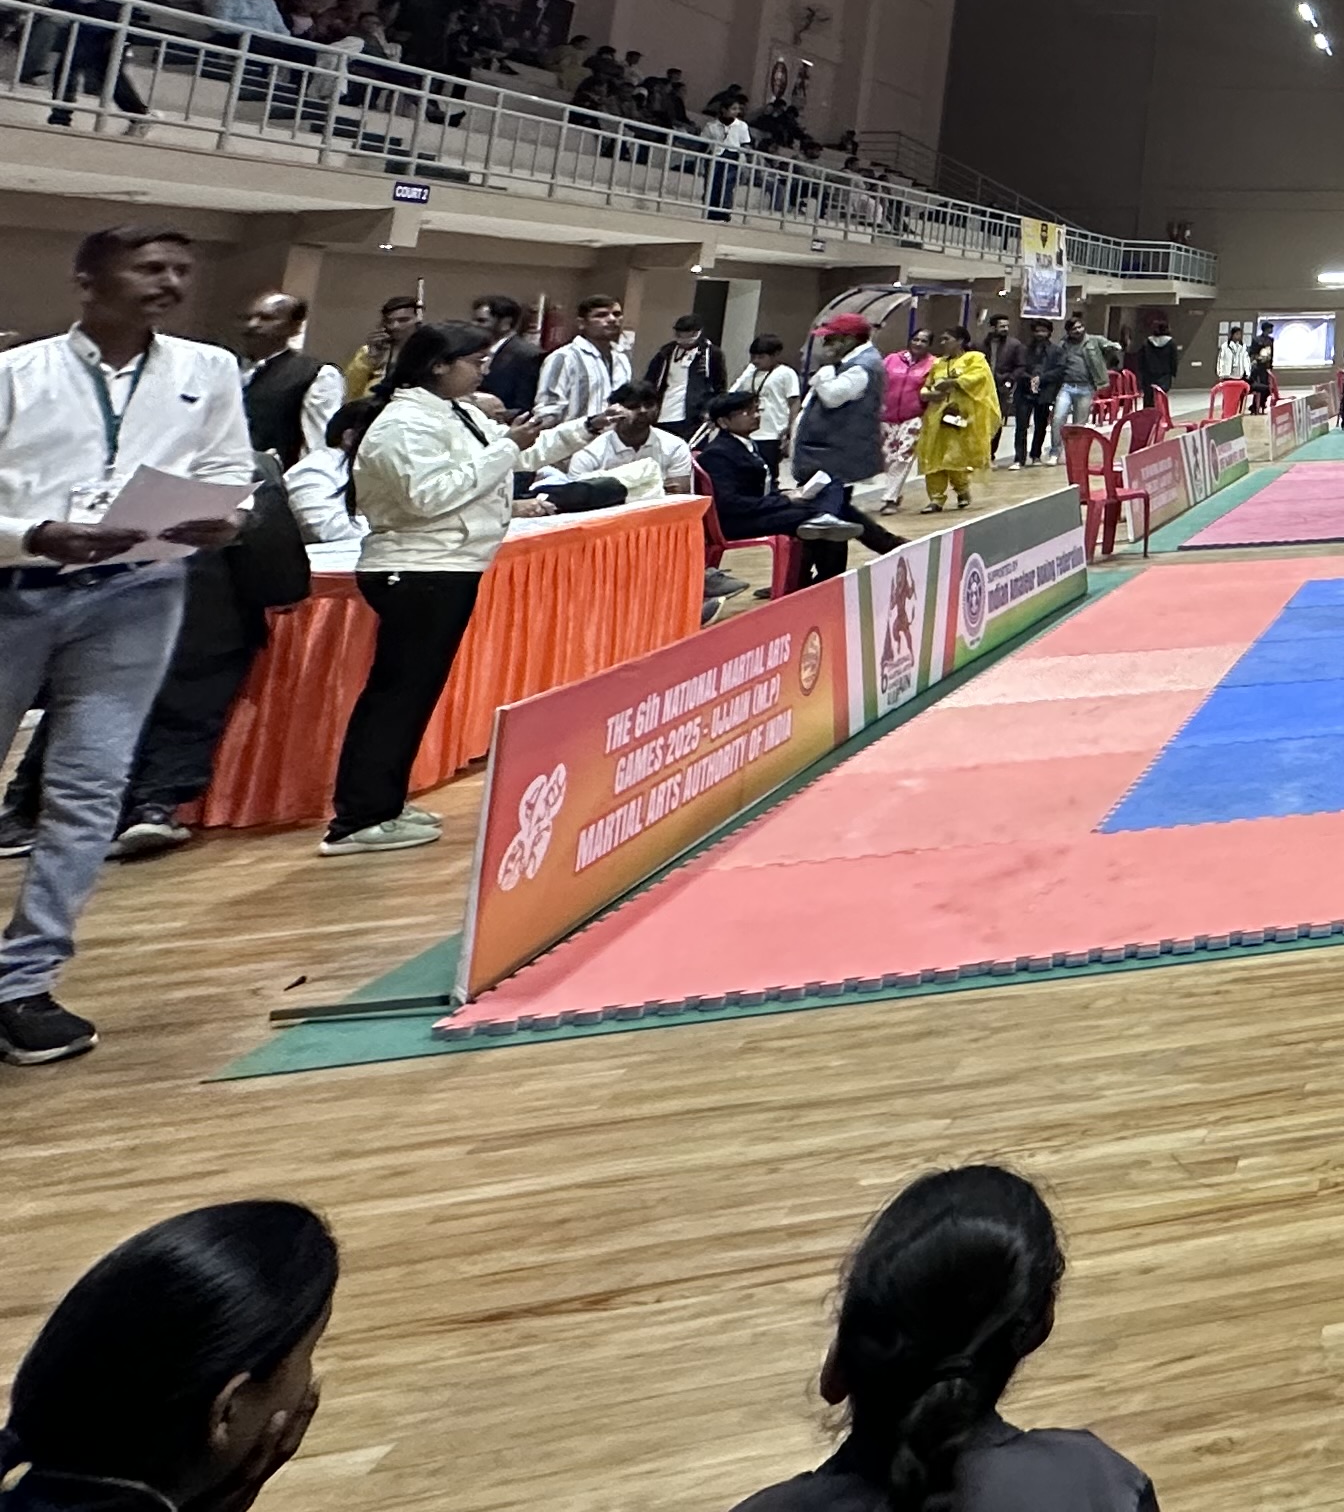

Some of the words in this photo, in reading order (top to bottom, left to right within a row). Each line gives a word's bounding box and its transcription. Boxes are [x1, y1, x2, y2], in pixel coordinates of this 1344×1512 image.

[396, 186, 422, 199] COURT
[605, 707, 633, 754] THE
[634, 692, 660, 738] 6th
[661, 668, 718, 723] NATIONAL
[720, 646, 765, 694] MARTIAL
[766, 633, 791, 670] ARTS
[614, 737, 664, 795] GAMES
[665, 717, 701, 765] 2025
[710, 689, 750, 739] UJJAIN
[575, 795, 643, 873] MARTIAL
[645, 771, 682, 827] ARTS
[682, 735, 749, 804] AUTHORITY
[748, 724, 764, 762] OF
[764, 709, 792, 753] INDIA
